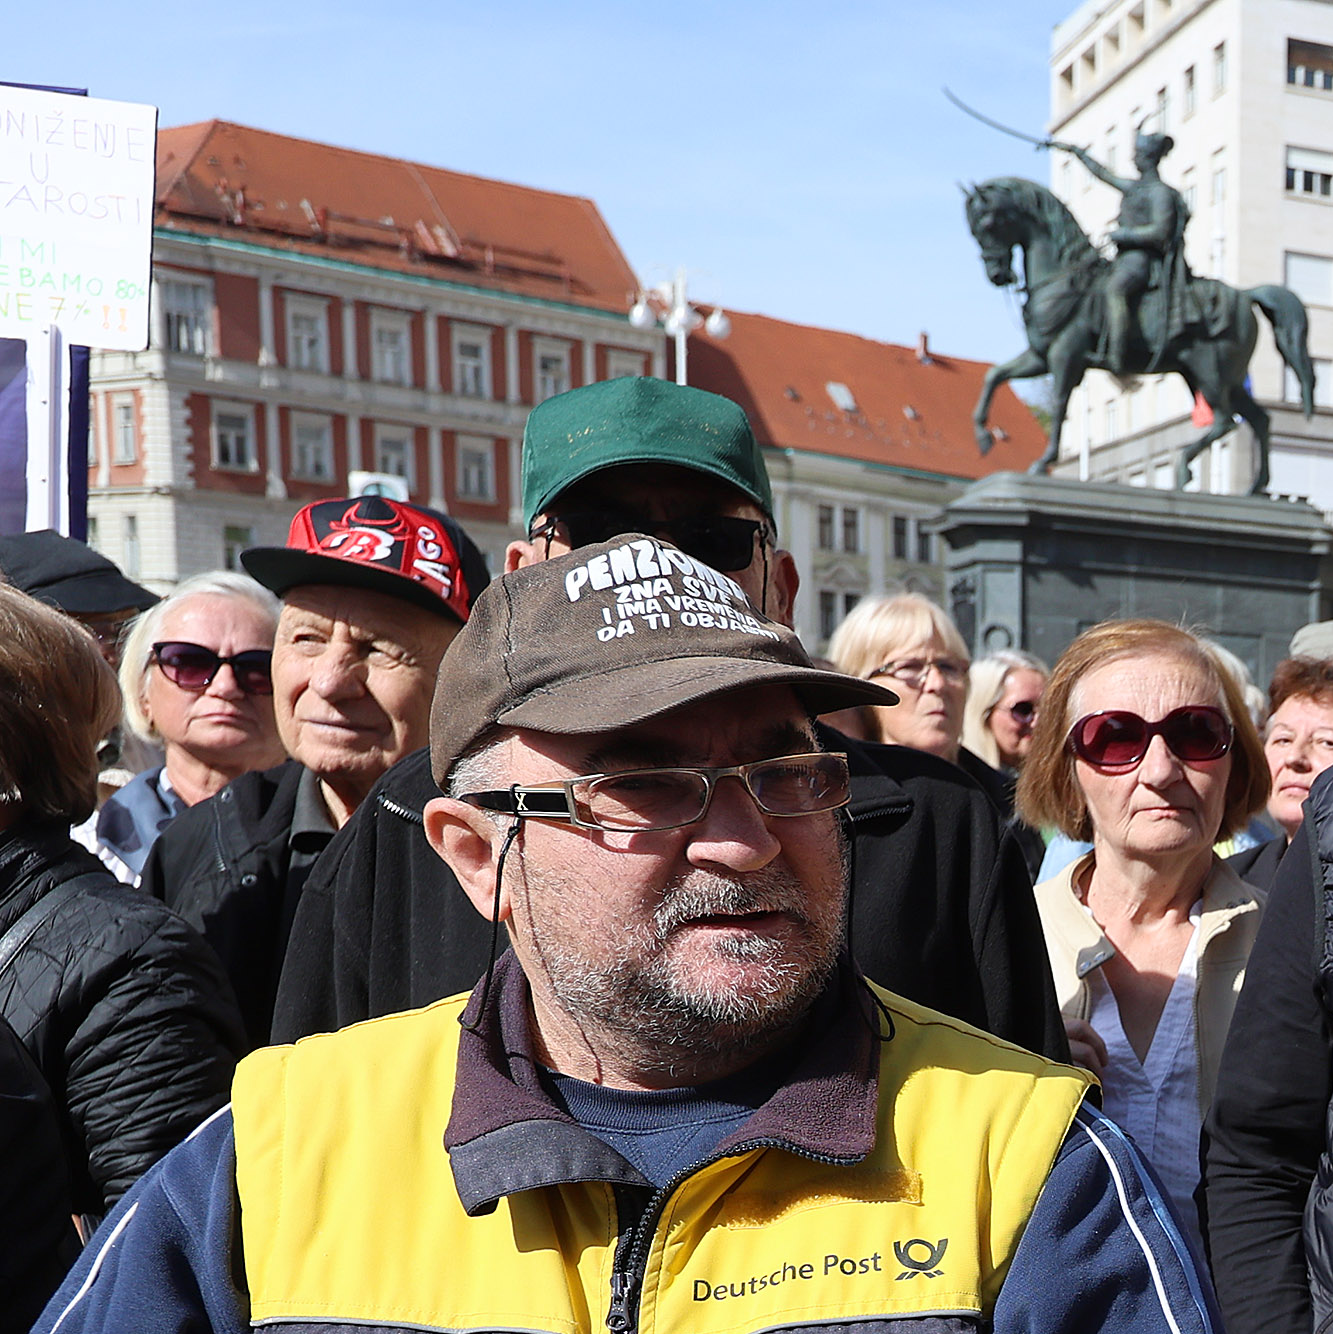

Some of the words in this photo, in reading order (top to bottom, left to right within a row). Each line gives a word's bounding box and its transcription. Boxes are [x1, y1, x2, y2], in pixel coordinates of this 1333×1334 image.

[0, 109, 145, 162] NIŽENJE
[29, 151, 50, 184] U
[20, 237, 57, 265] MI
[412, 526, 452, 599] AGO
[564, 539, 751, 610] PENZIONER
[613, 577, 675, 604] ZNA
[682, 575, 732, 607] SVE
[596, 619, 636, 642] DA
[642, 612, 671, 630] TI
[602, 607, 612, 625] I
[616, 599, 663, 620] IMA
[662, 594, 761, 630] VREMENA
[692, 1261, 815, 1303] Deutsche
[823, 1251, 883, 1277] Post
